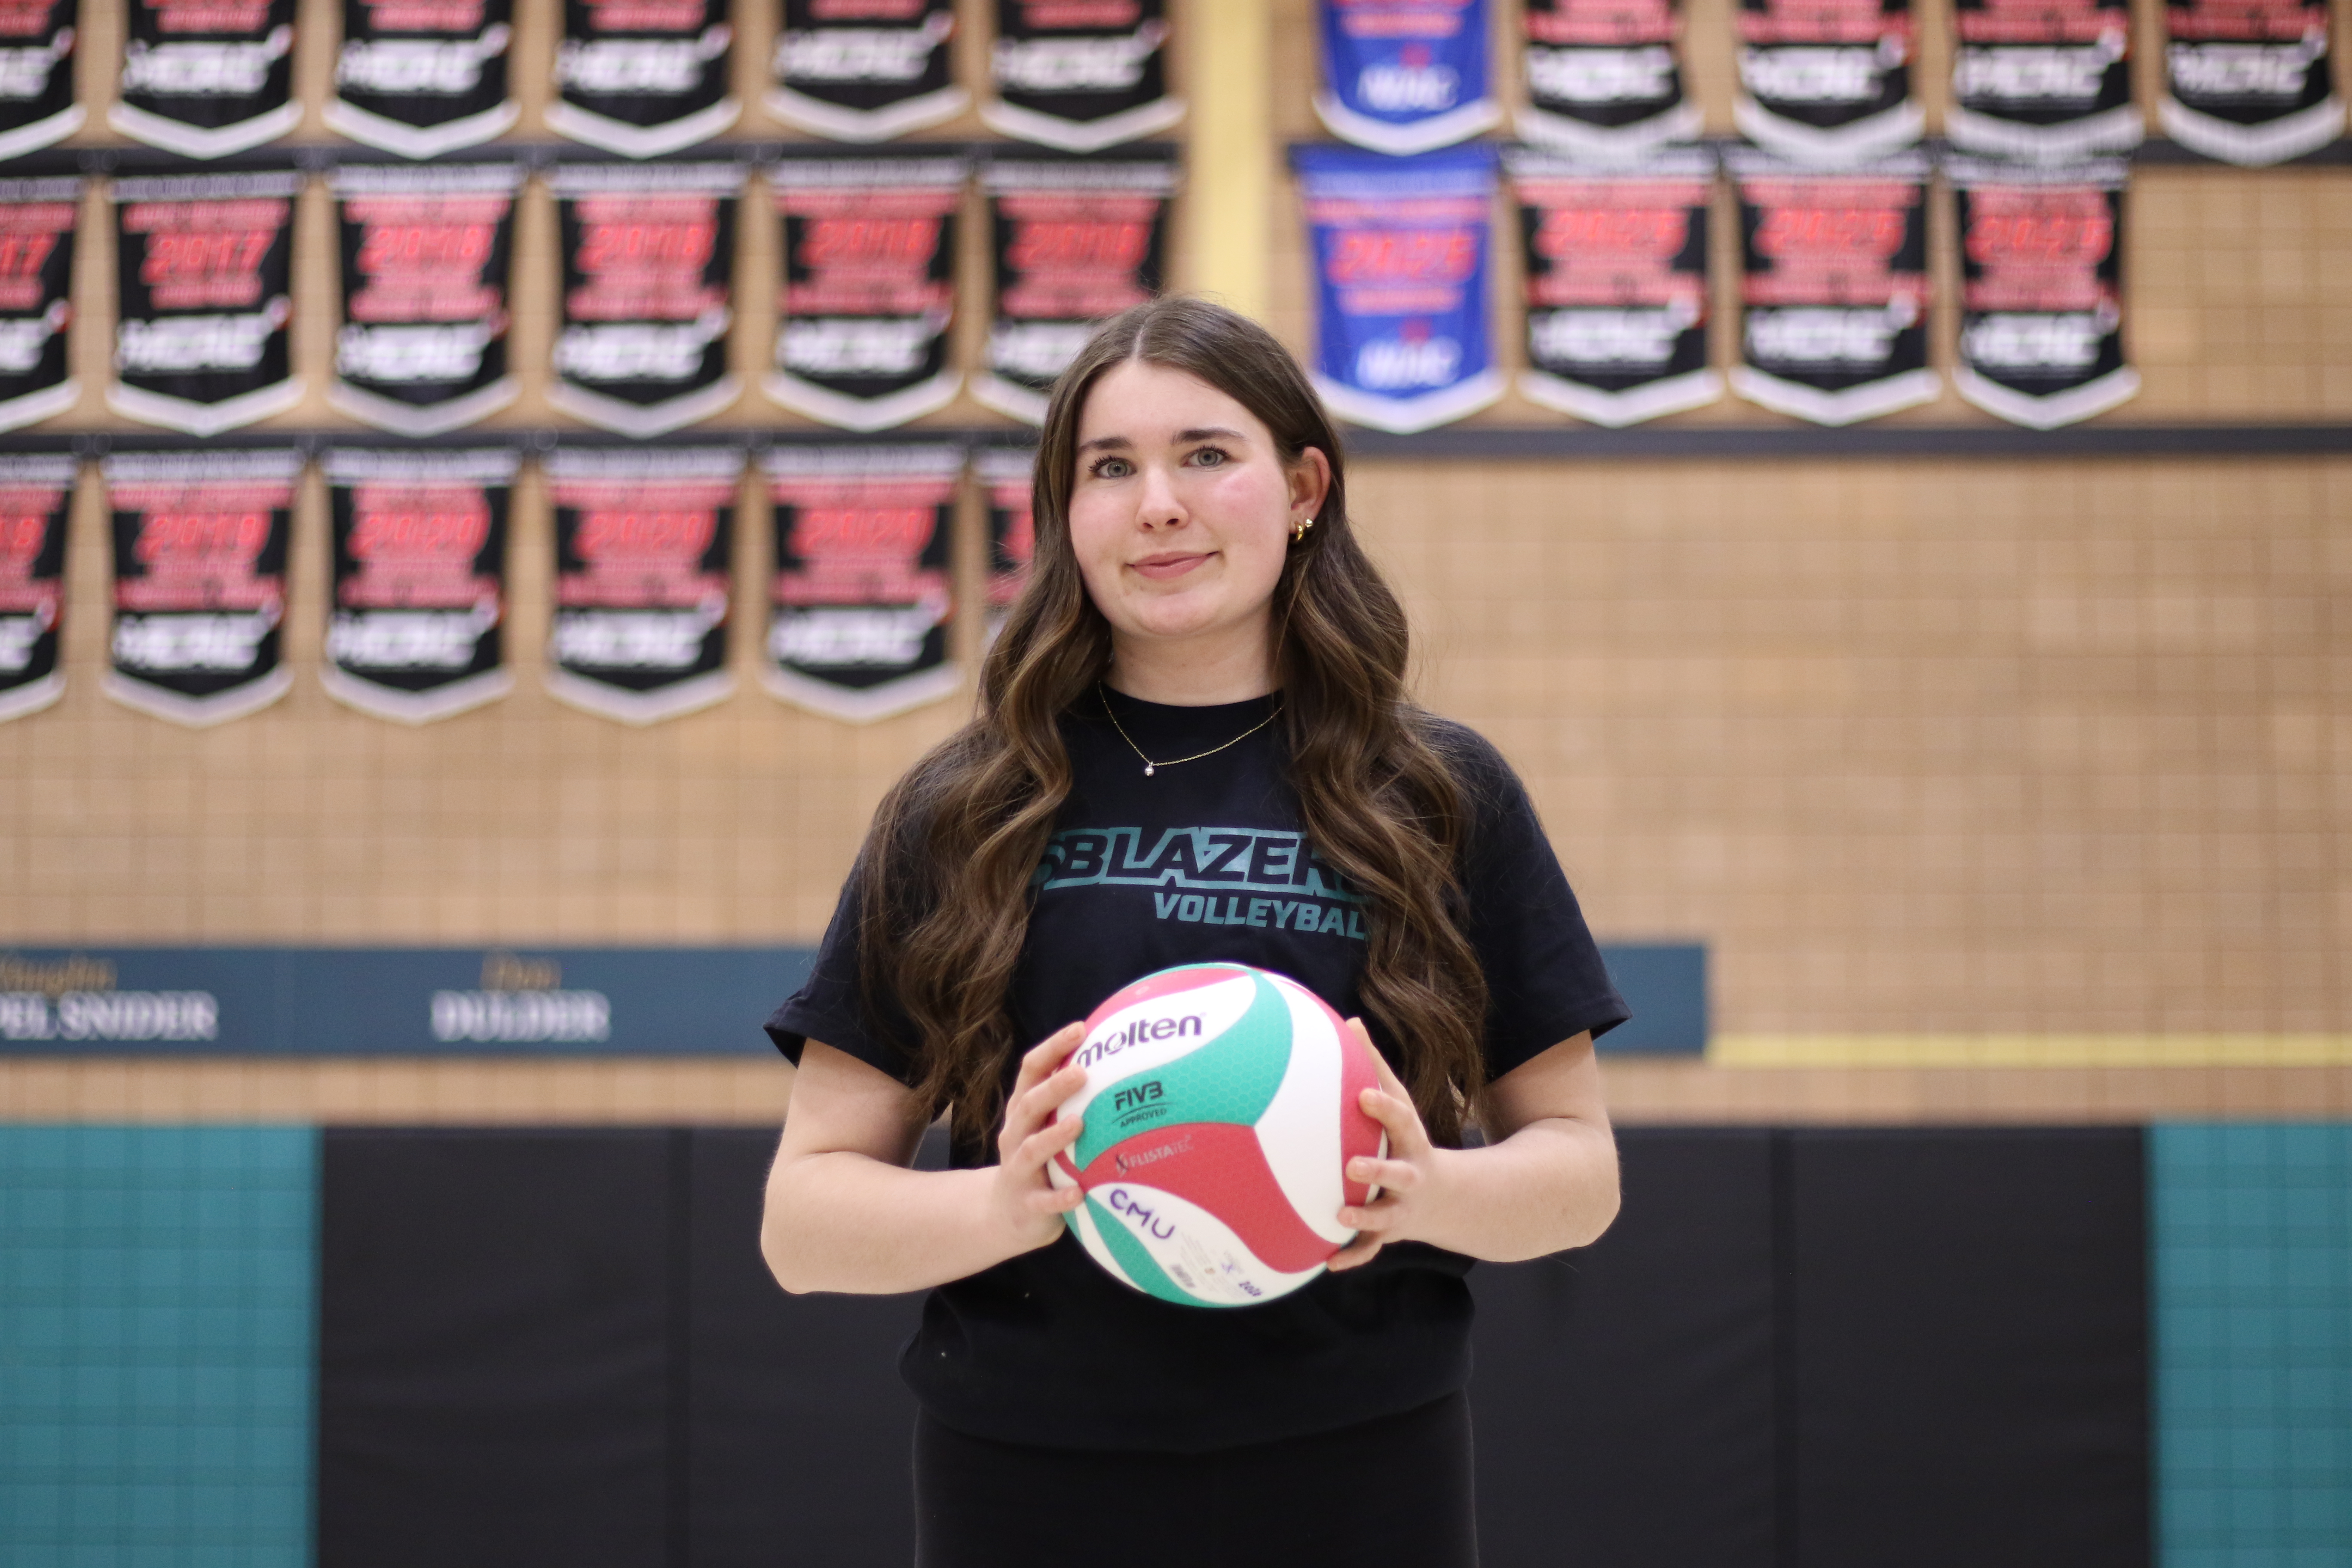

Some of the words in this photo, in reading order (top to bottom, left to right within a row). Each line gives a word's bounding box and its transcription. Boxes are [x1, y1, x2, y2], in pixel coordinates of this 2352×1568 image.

[140, 231, 277, 285] 2017
[1042, 826, 1369, 903] BLAZER
[1154, 892, 1367, 940] VOLLEYBAL
[58, 990, 218, 1040] SNIDER
[1077, 1015, 1201, 1068] molten
[1120, 1108, 1167, 1128] APPROVED
[1128, 1140, 1193, 1168] FLISTATEC
[1110, 1188, 1176, 1239] CMU
